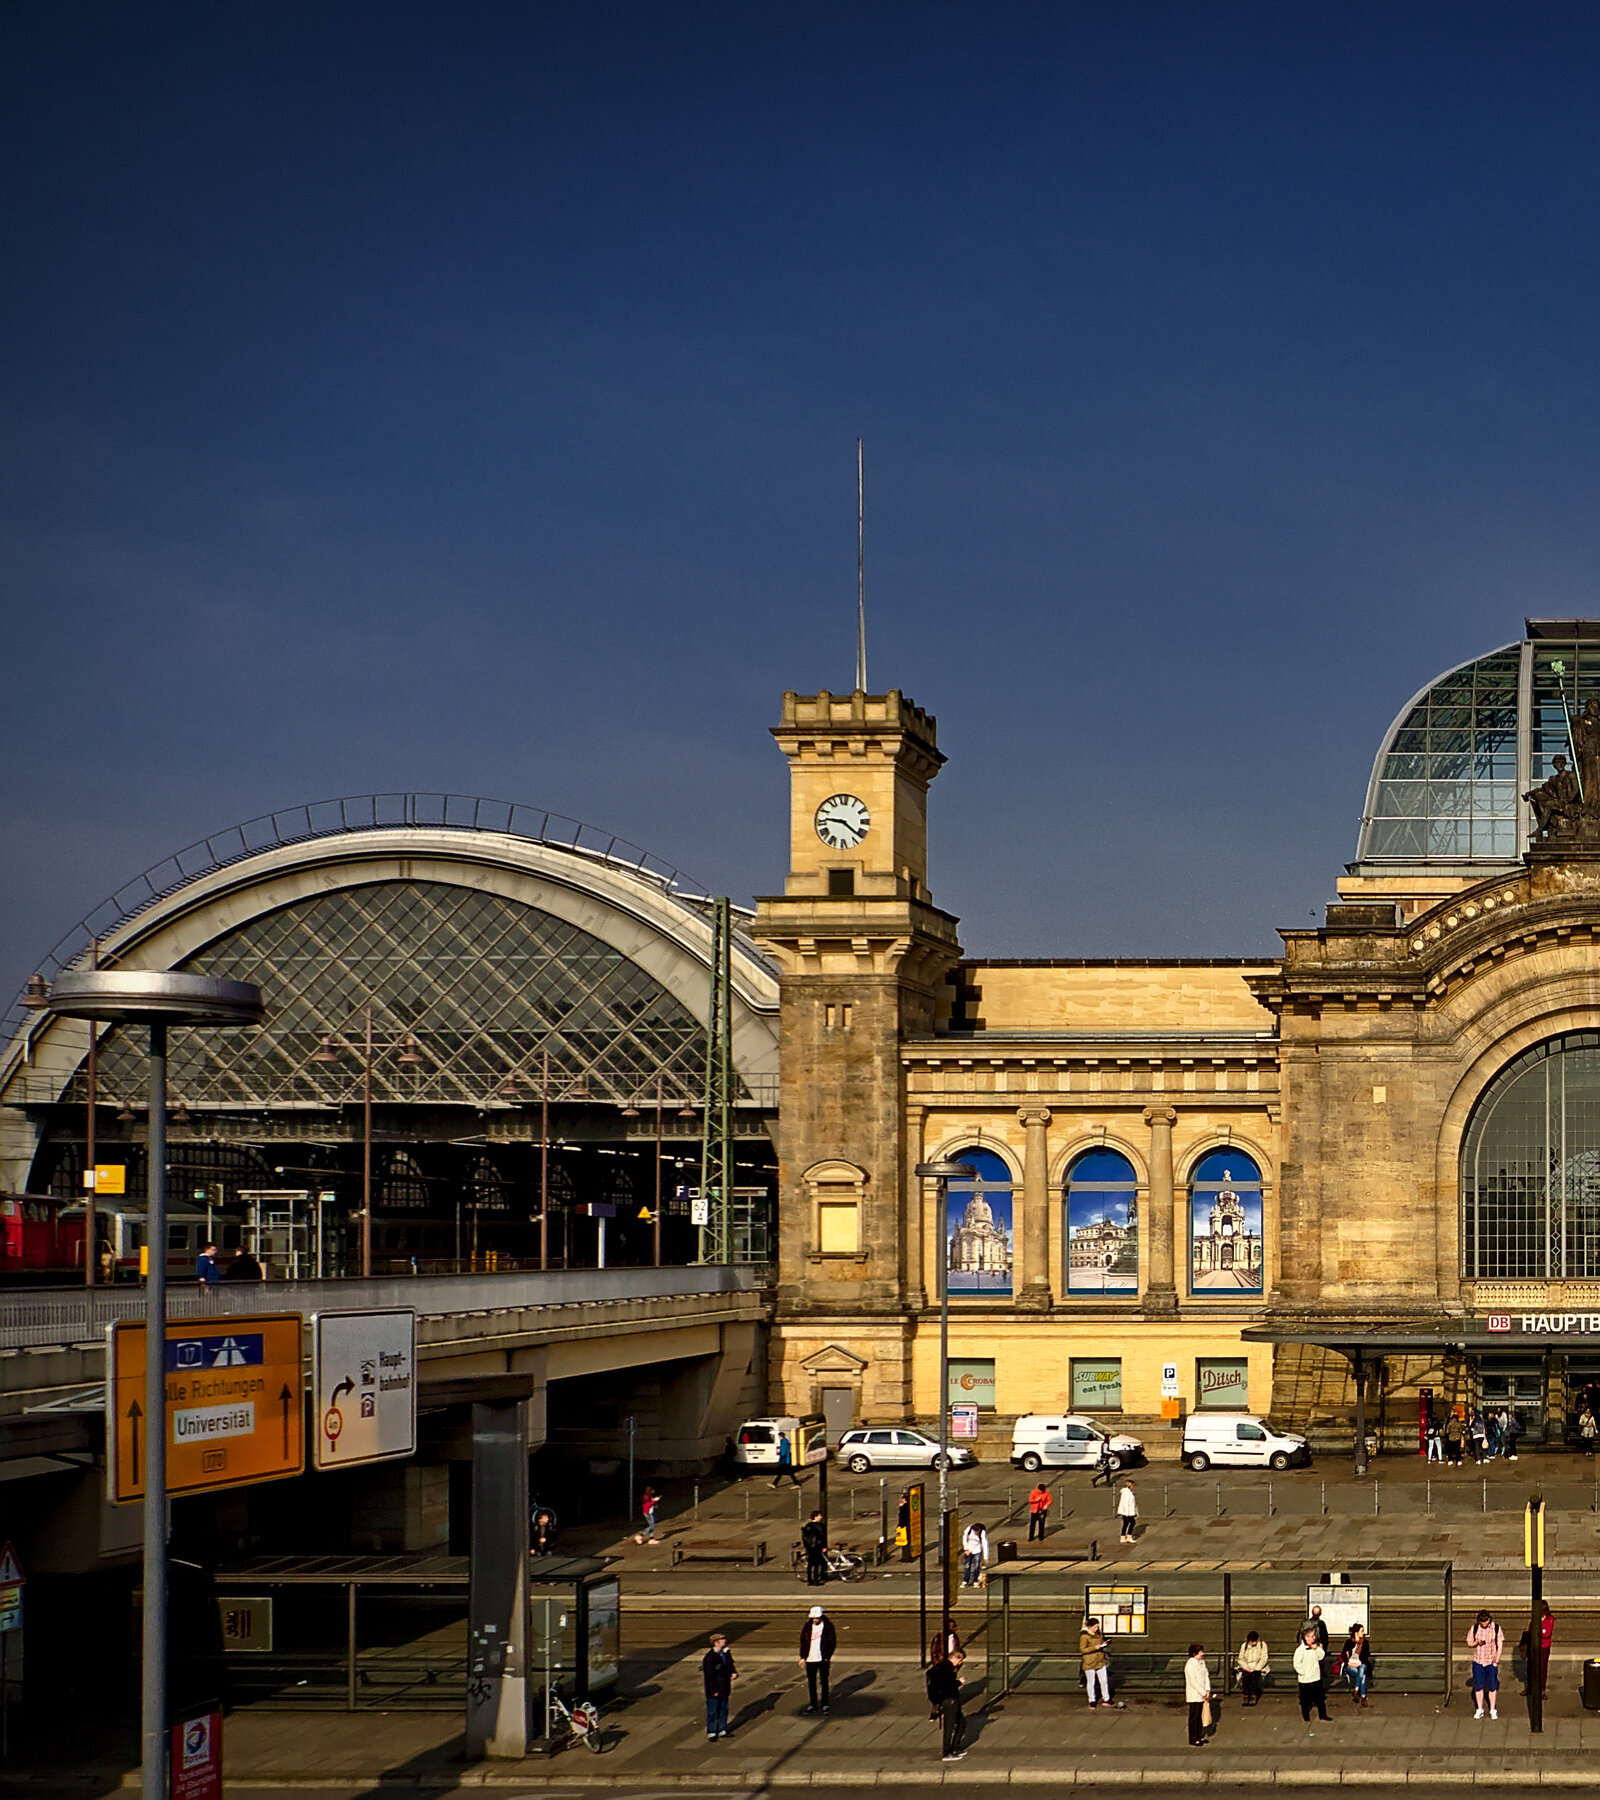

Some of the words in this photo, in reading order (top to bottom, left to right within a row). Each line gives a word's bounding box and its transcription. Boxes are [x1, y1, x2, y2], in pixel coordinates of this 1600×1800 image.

[676, 1186, 685, 1197] F
[1490, 1316, 1509, 1329] DB
[184, 1347, 195, 1362] 17
[1074, 1370, 1120, 1383] SUBWAY
[1202, 1369, 1241, 1389] Ditsch
[191, 1377, 265, 1399] Richtungen
[1082, 1385, 1097, 1393] eat
[1098, 1381, 1121, 1391] fresh
[177, 1409, 251, 1436] Universität
